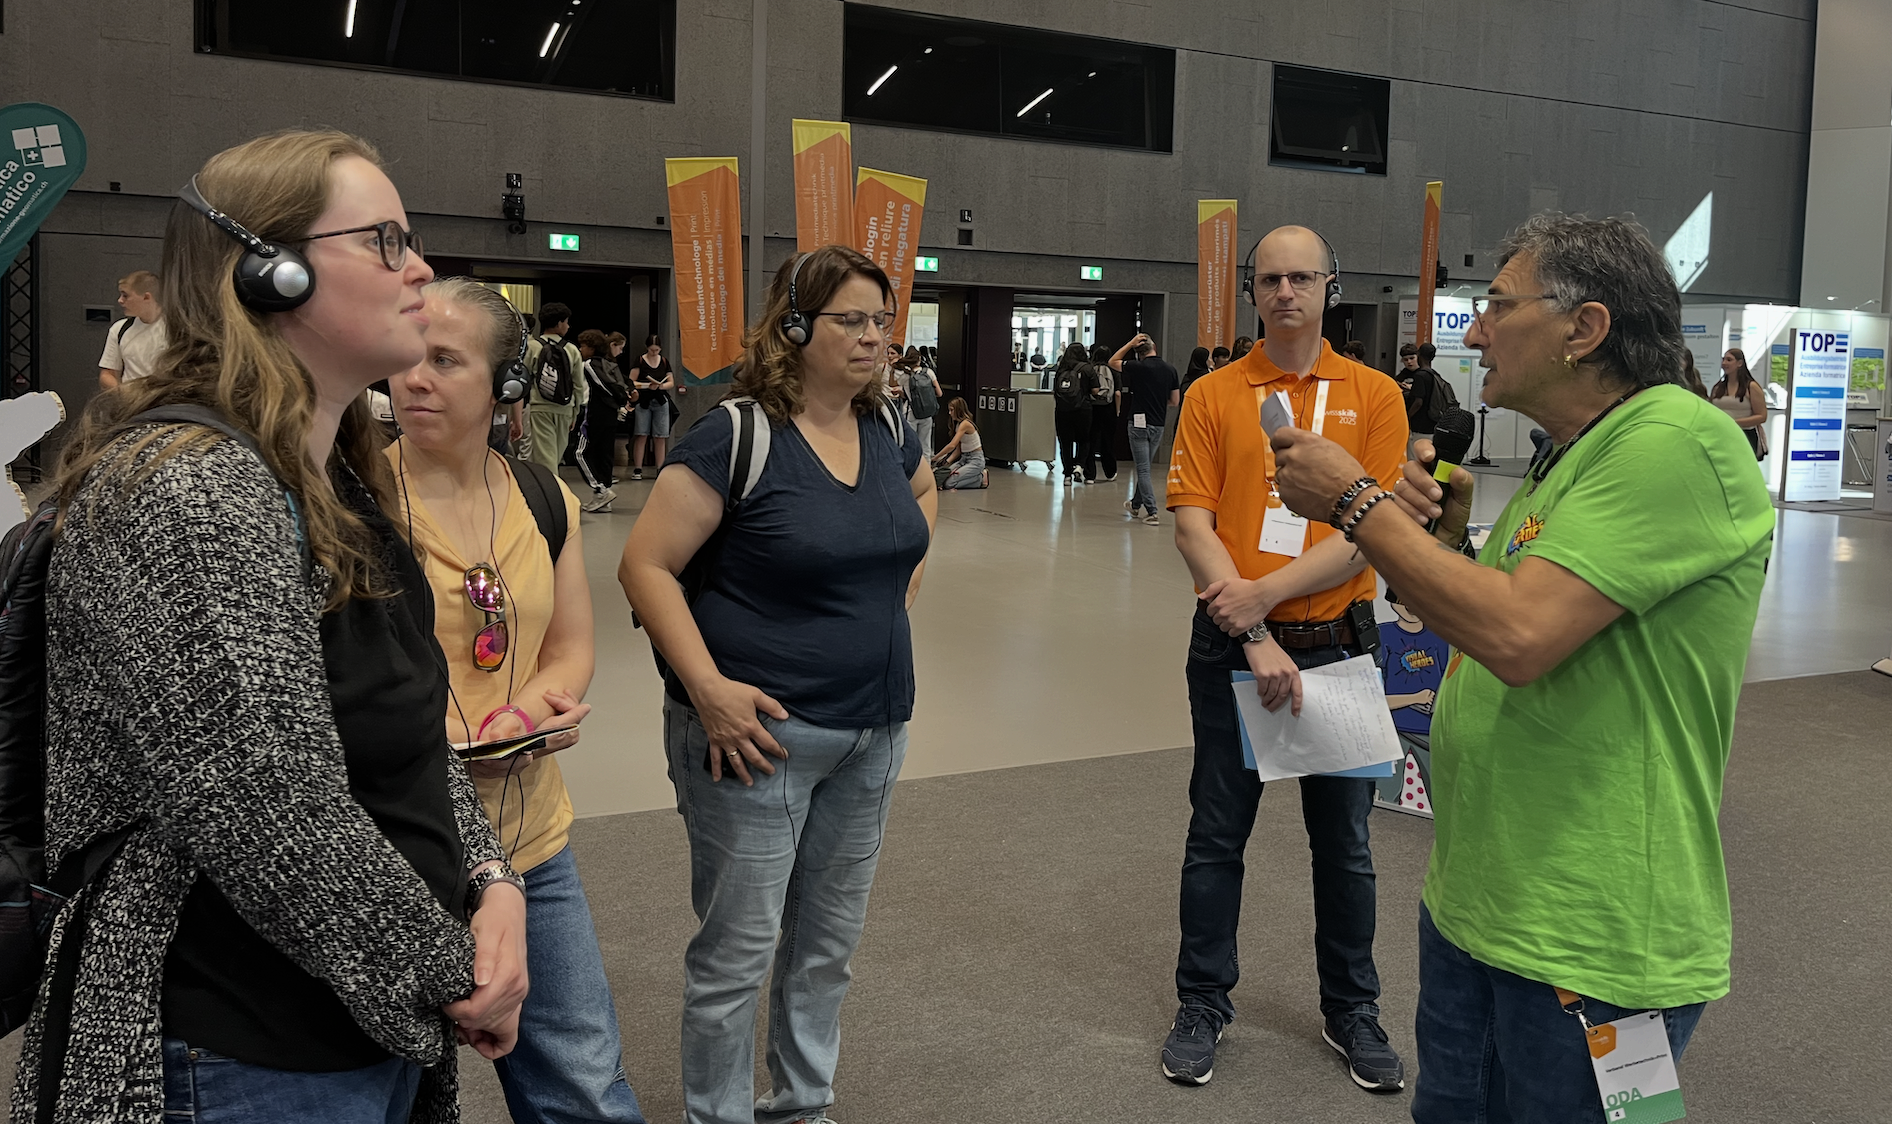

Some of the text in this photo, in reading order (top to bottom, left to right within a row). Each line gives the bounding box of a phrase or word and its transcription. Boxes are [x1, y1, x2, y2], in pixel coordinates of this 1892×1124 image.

[0, 160, 19, 190] ica
[702, 190, 711, 233] Impression
[690, 214, 698, 233] Print
[879, 201, 896, 269] en reliure
[893, 203, 911, 273] rilegatura
[706, 239, 714, 274] médias
[693, 240, 706, 330] Medientechnologe
[709, 277, 715, 289] en
[890, 275, 901, 290] di
[719, 284, 729, 333] Tecnologo
[1214, 310, 1221, 322] de
[1435, 312, 1470, 329] TOP
[1799, 332, 1835, 352] TOP
[1325, 409, 1357, 417] wissskills
[1338, 417, 1356, 425] 2025
[1606, 1087, 1643, 1108] ODA
